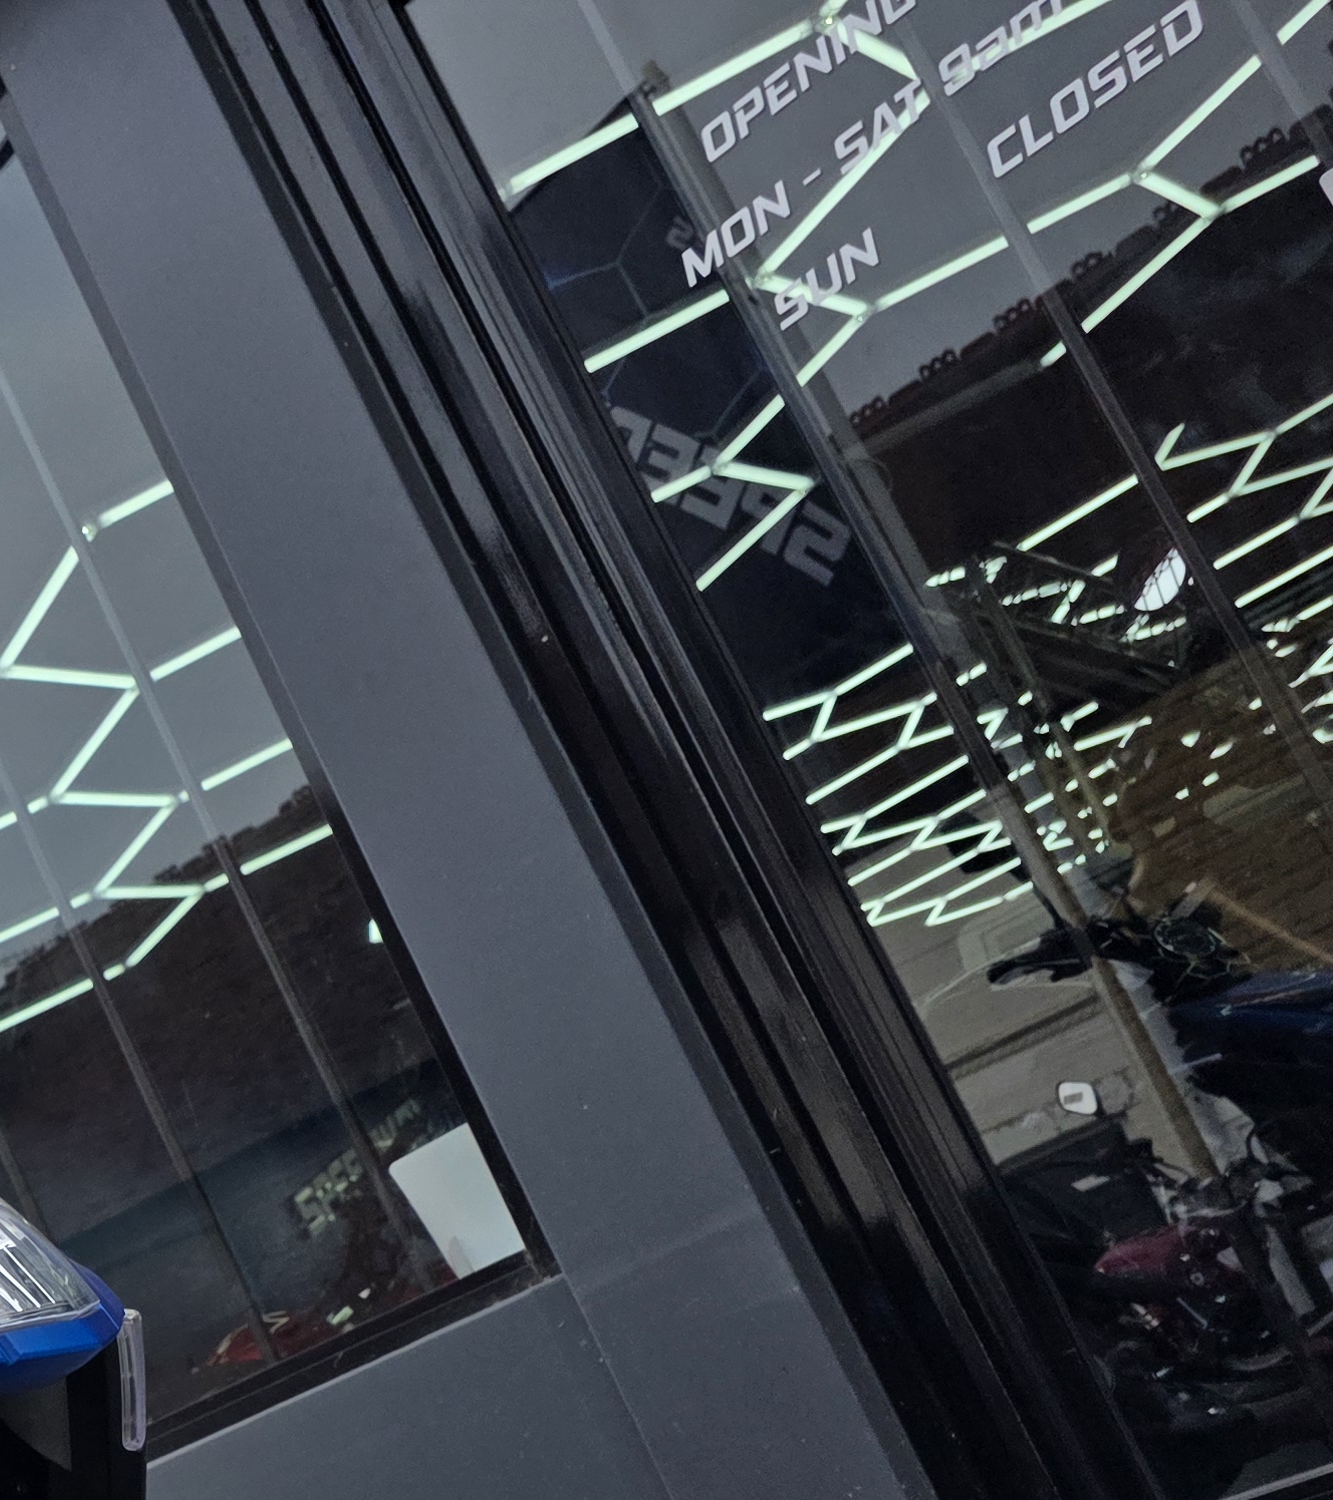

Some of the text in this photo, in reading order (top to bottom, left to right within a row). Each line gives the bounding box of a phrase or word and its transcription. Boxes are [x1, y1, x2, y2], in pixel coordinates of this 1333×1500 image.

[681, 180, 791, 288] MON
[833, 78, 922, 176] SAT
[773, 0, 1204, 331] SUN CLOSED
